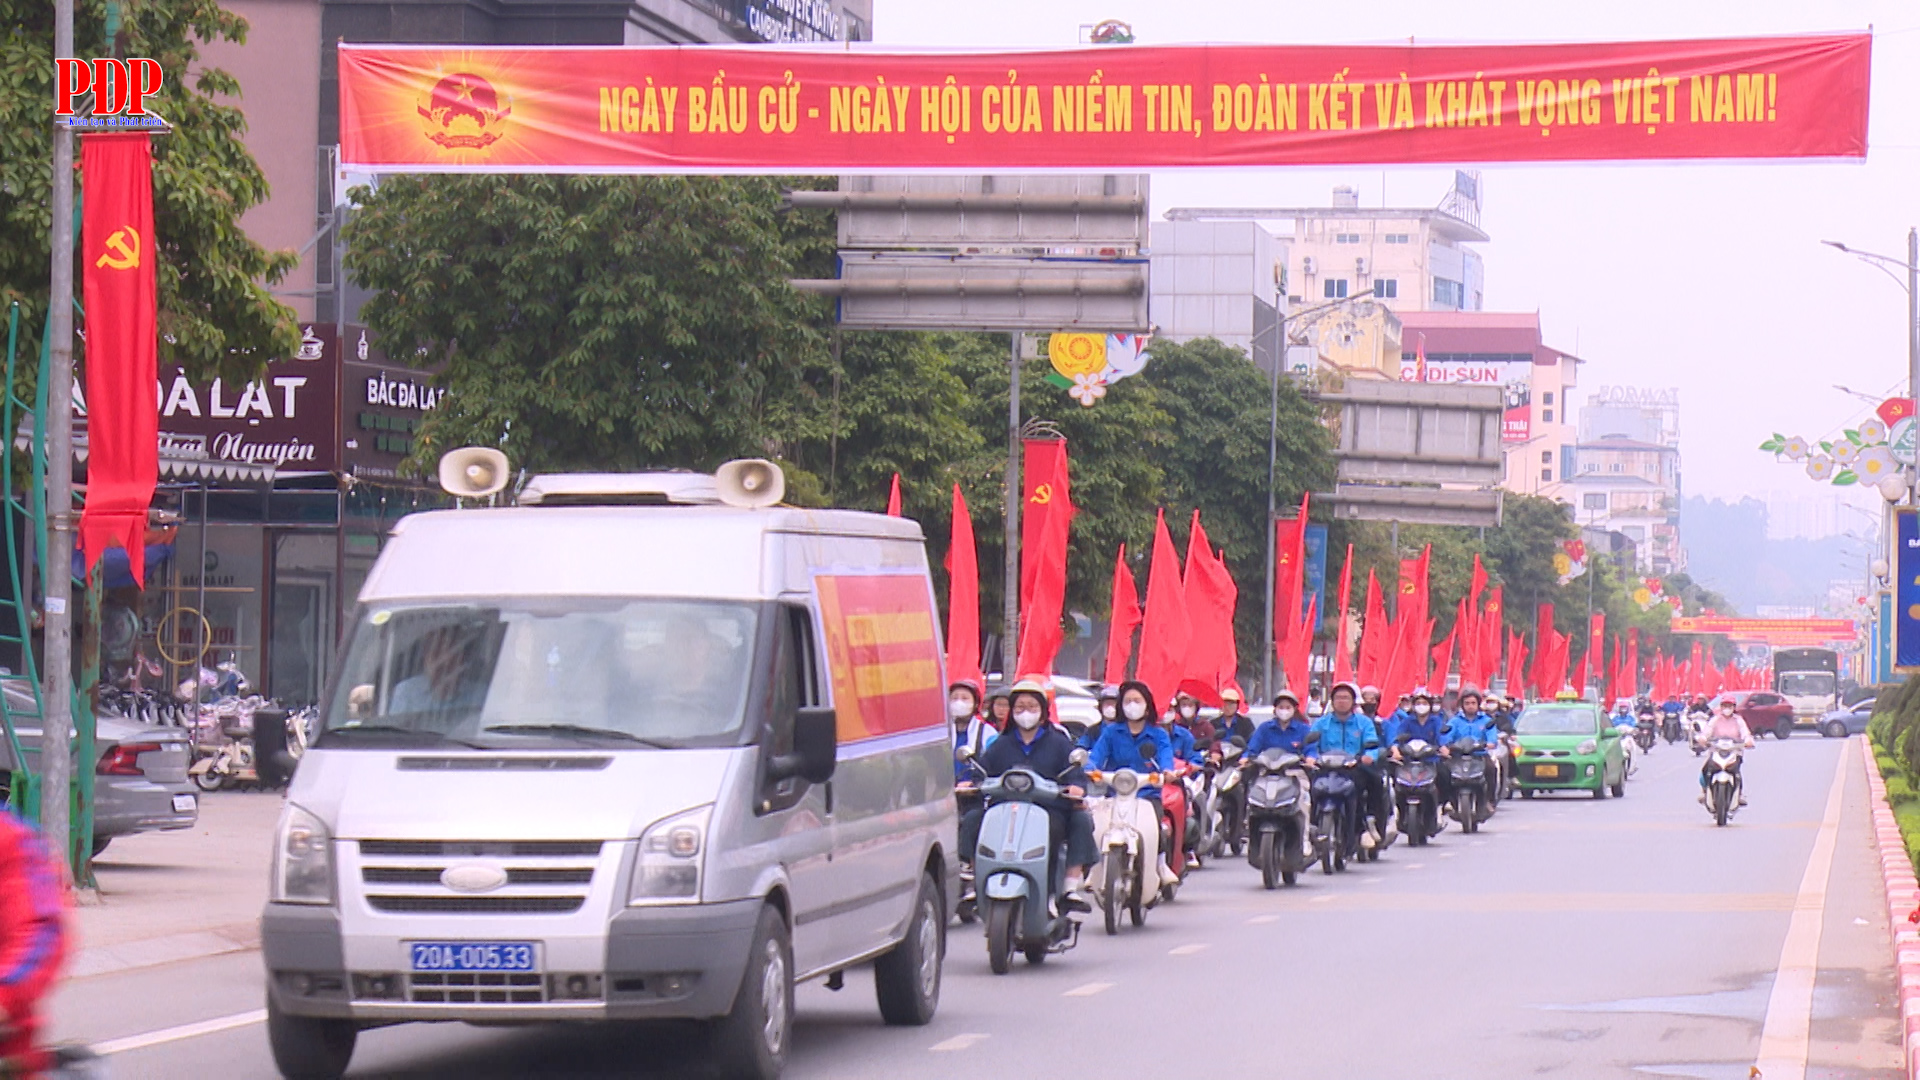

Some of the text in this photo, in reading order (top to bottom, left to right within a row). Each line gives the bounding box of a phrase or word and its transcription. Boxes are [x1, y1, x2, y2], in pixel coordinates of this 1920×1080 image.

[600, 67, 1777, 144] NGÀY BẦU CỬ - NGÀY HỘI CỦA NIỀM TIN, ĐOÀN KẾT VÀ KHÁT VỌNG VIỆT NAM!
[1401, 367, 1498, 382] CDI-SUN
[158, 366, 308, 426] À LẠT
[398, 378, 418, 408] ĐÀ
[213, 431, 316, 466] Nguyên
[415, 946, 530, 969] 20A-005.33
